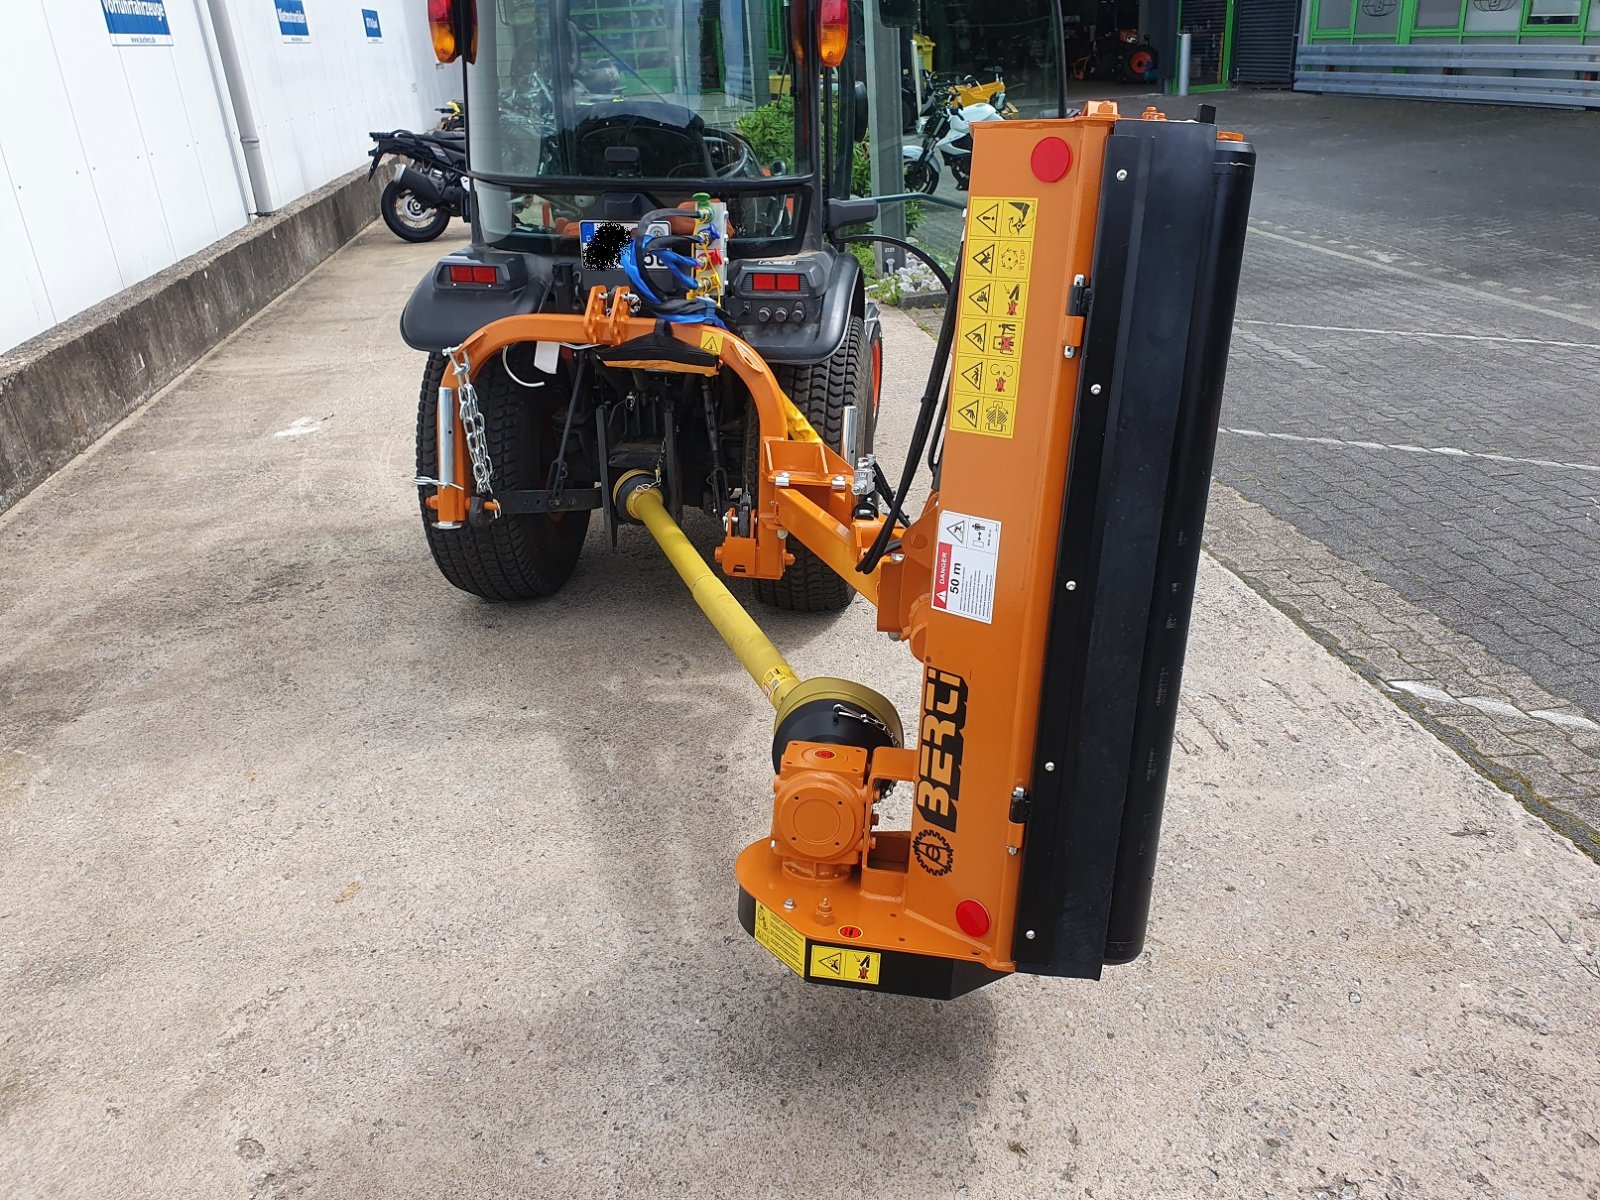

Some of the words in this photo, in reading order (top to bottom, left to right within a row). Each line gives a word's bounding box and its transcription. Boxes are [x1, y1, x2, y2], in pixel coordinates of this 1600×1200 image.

[939, 552, 948, 585] DANGER
[953, 563, 961, 575] m
[950, 579, 960, 594] 50
